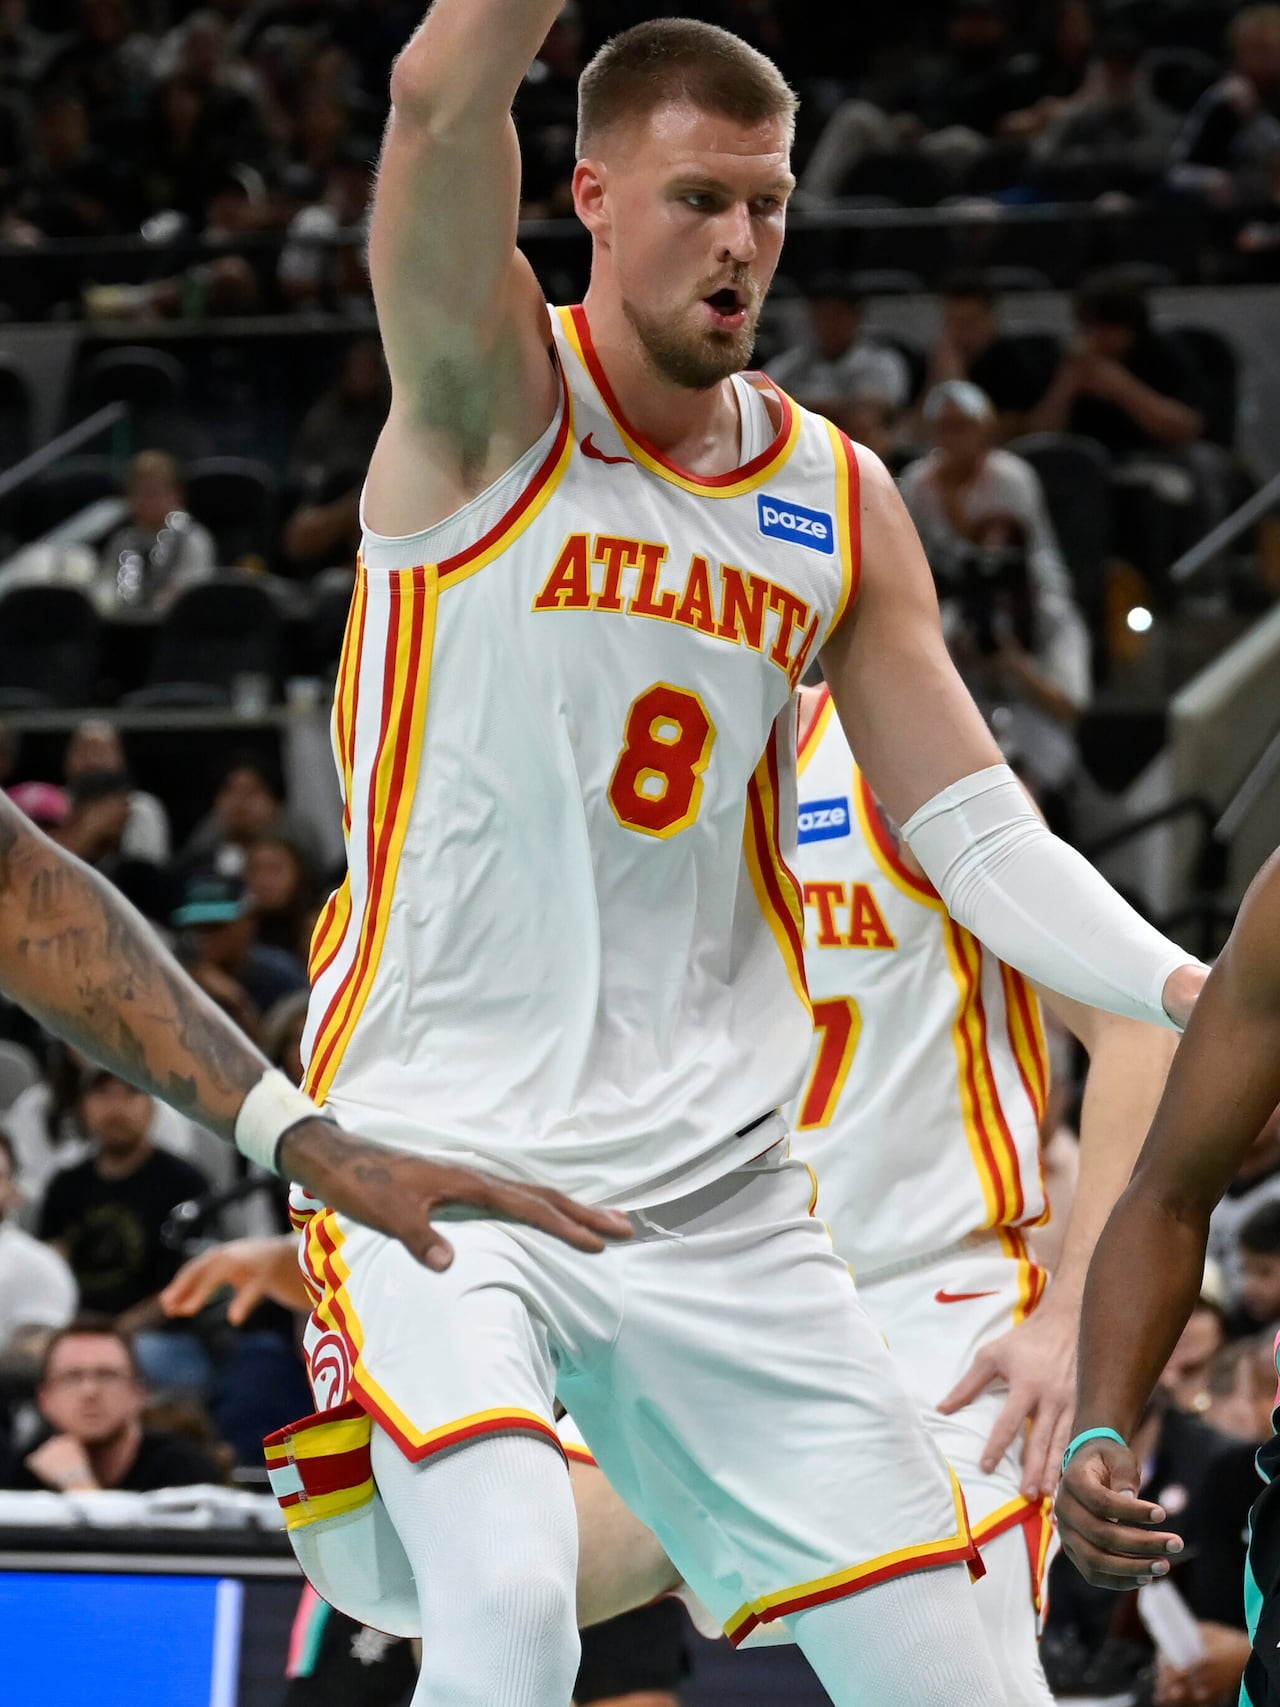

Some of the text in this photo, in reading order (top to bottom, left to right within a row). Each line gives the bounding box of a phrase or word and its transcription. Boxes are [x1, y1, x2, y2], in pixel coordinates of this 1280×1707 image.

[761, 504, 828, 541] paze
[531, 532, 821, 696] ATLANTA
[608, 681, 718, 841] 8
